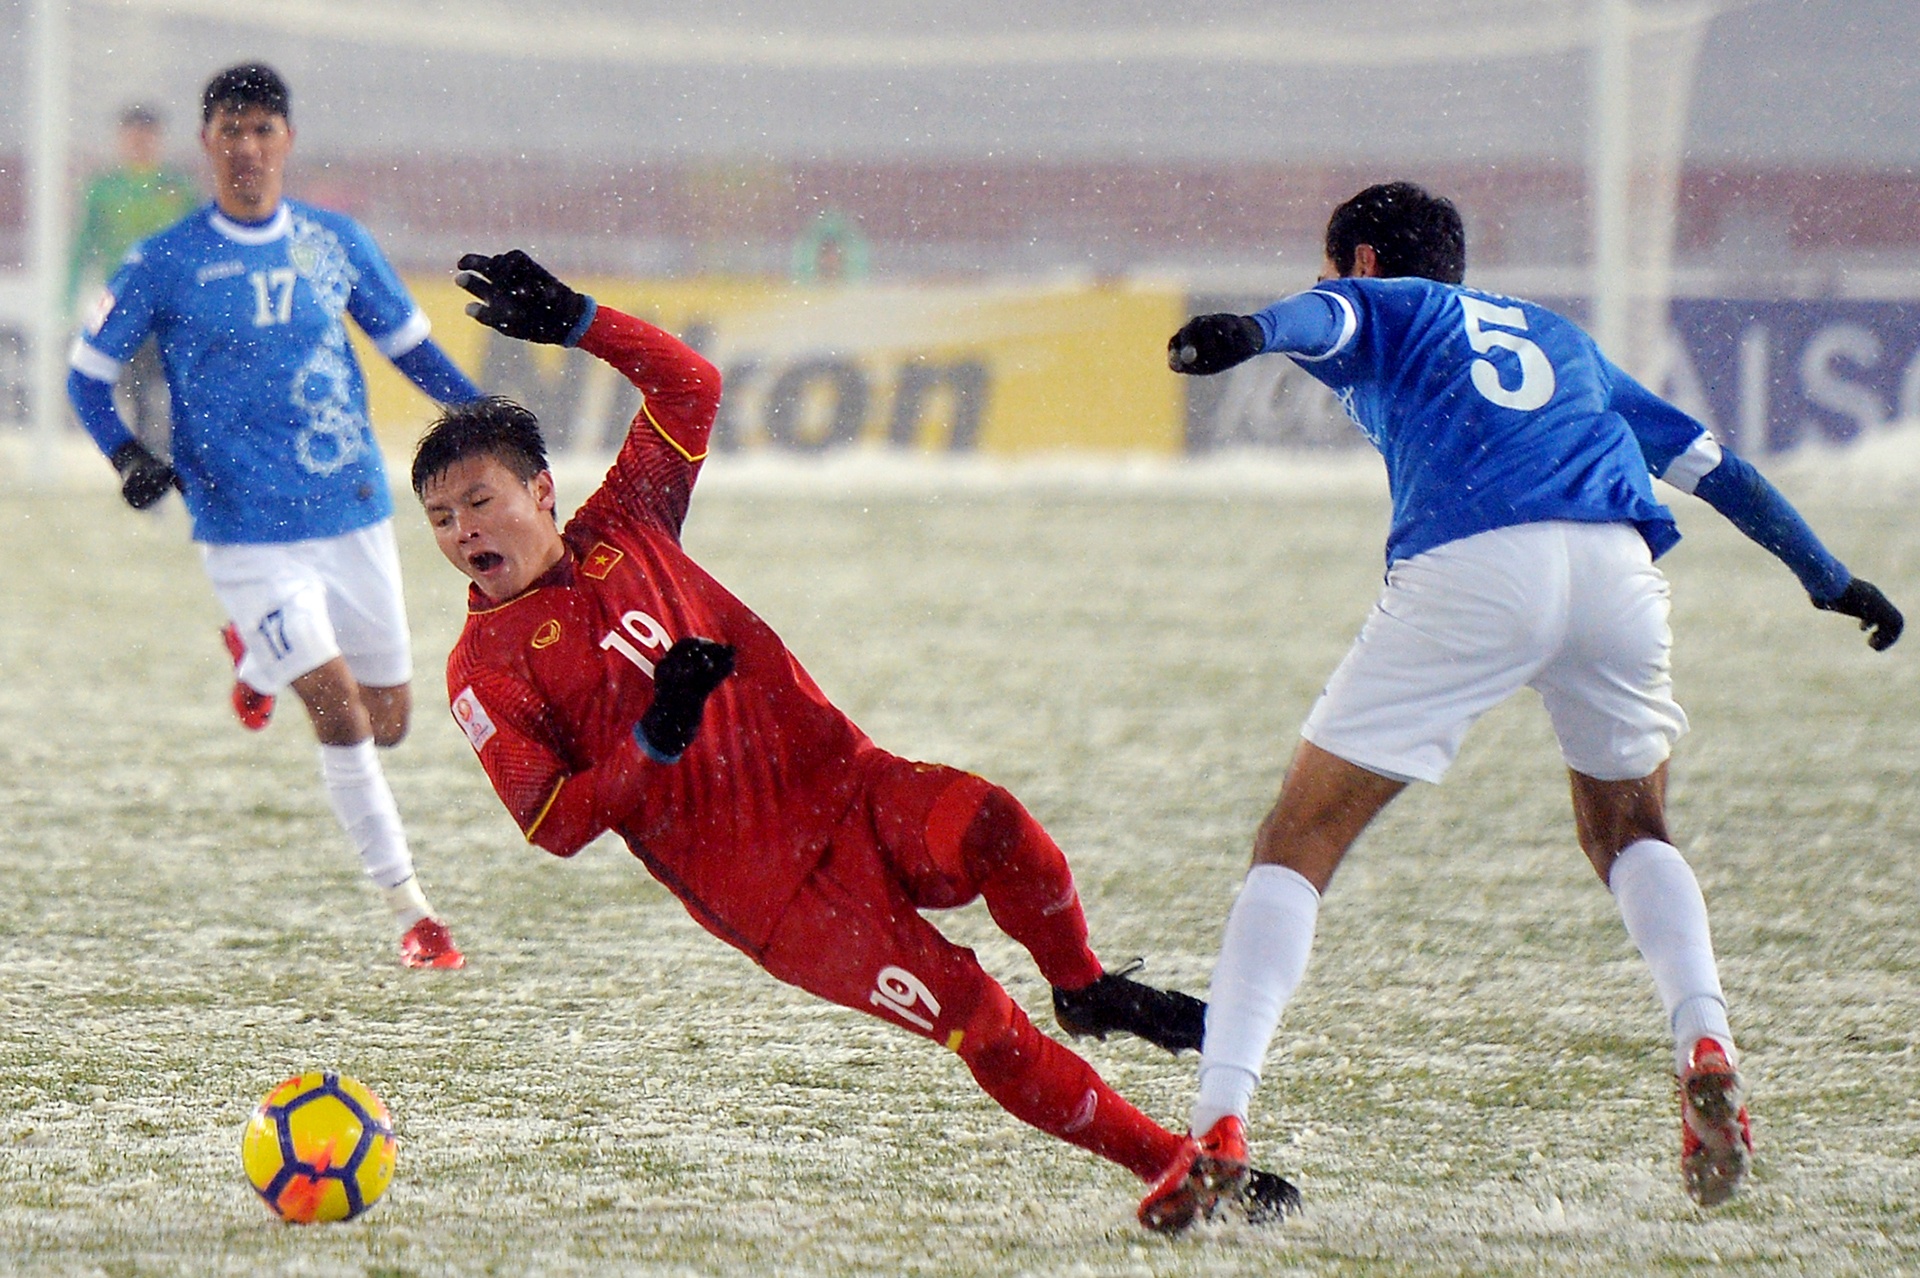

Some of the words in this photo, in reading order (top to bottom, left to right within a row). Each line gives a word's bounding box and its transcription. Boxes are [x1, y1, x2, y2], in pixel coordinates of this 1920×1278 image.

[252, 267, 297, 327] 17
[1457, 294, 1556, 412] 5
[1645, 322, 1920, 456] AIS
[258, 608, 293, 660] 17
[600, 610, 674, 680] 19
[869, 966, 941, 1031] 19
